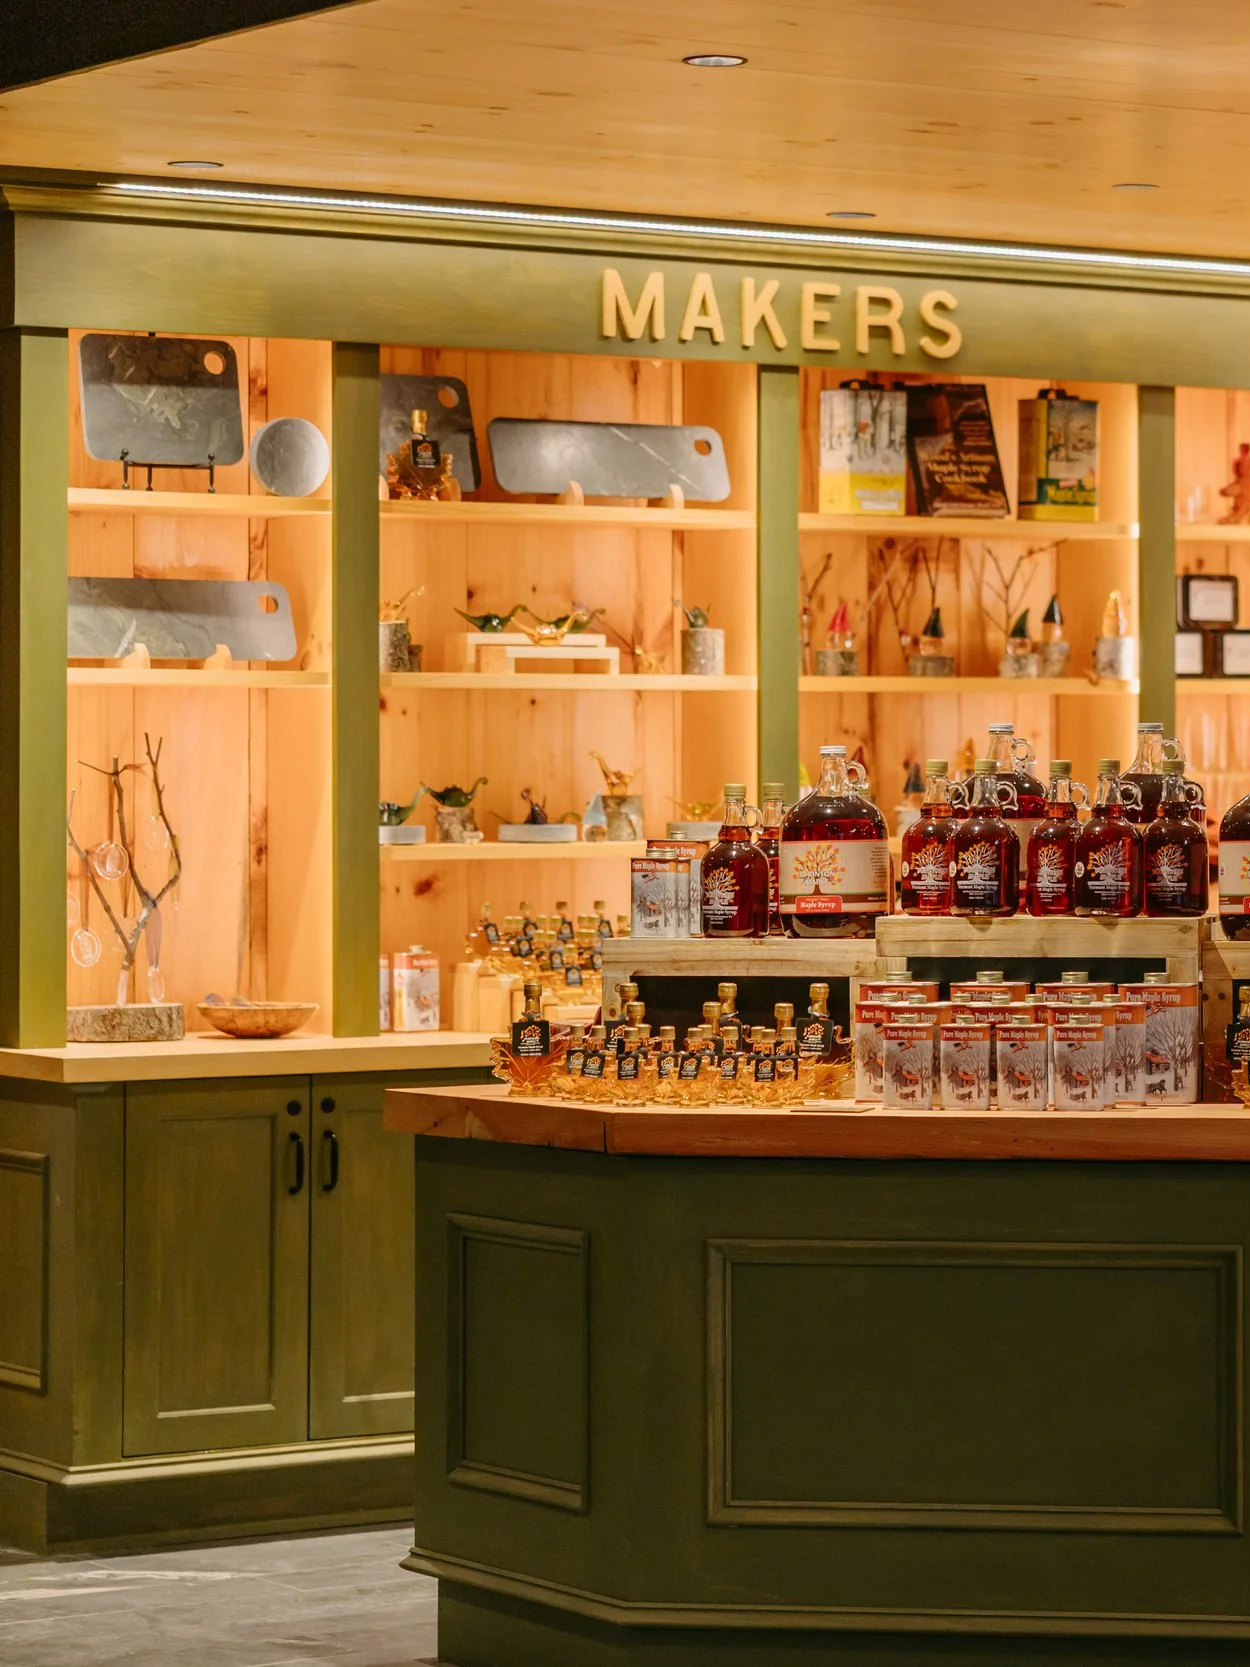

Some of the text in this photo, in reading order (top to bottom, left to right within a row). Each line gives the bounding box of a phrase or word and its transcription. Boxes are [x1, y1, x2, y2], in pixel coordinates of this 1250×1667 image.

[602, 268, 963, 360] MAKERS
[927, 462, 991, 474] Maple Syrup
[642, 862, 656, 871] Maple
[656, 862, 670, 871] Syrup
[1042, 991, 1058, 1001] Pure
[1126, 992, 1181, 1004] Pure Maple Syrup
[862, 1010, 874, 1019] Pure
[921, 1012, 937, 1023] Syrup
[975, 1012, 988, 1021] Pure
[988, 1012, 1004, 1022] Maple
[1055, 1013, 1068, 1021] Pure
[1115, 1011, 1133, 1021] Syrup
[898, 1030, 912, 1039] Maple
[912, 1030, 927, 1039] Syrup
[943, 1030, 983, 1040] Pure Maple Syrup
[999, 1030, 1040, 1040] Pure Maple Syrup
[1068, 1031, 1082, 1040] Maple
[1082, 1031, 1097, 1040] Syrup
